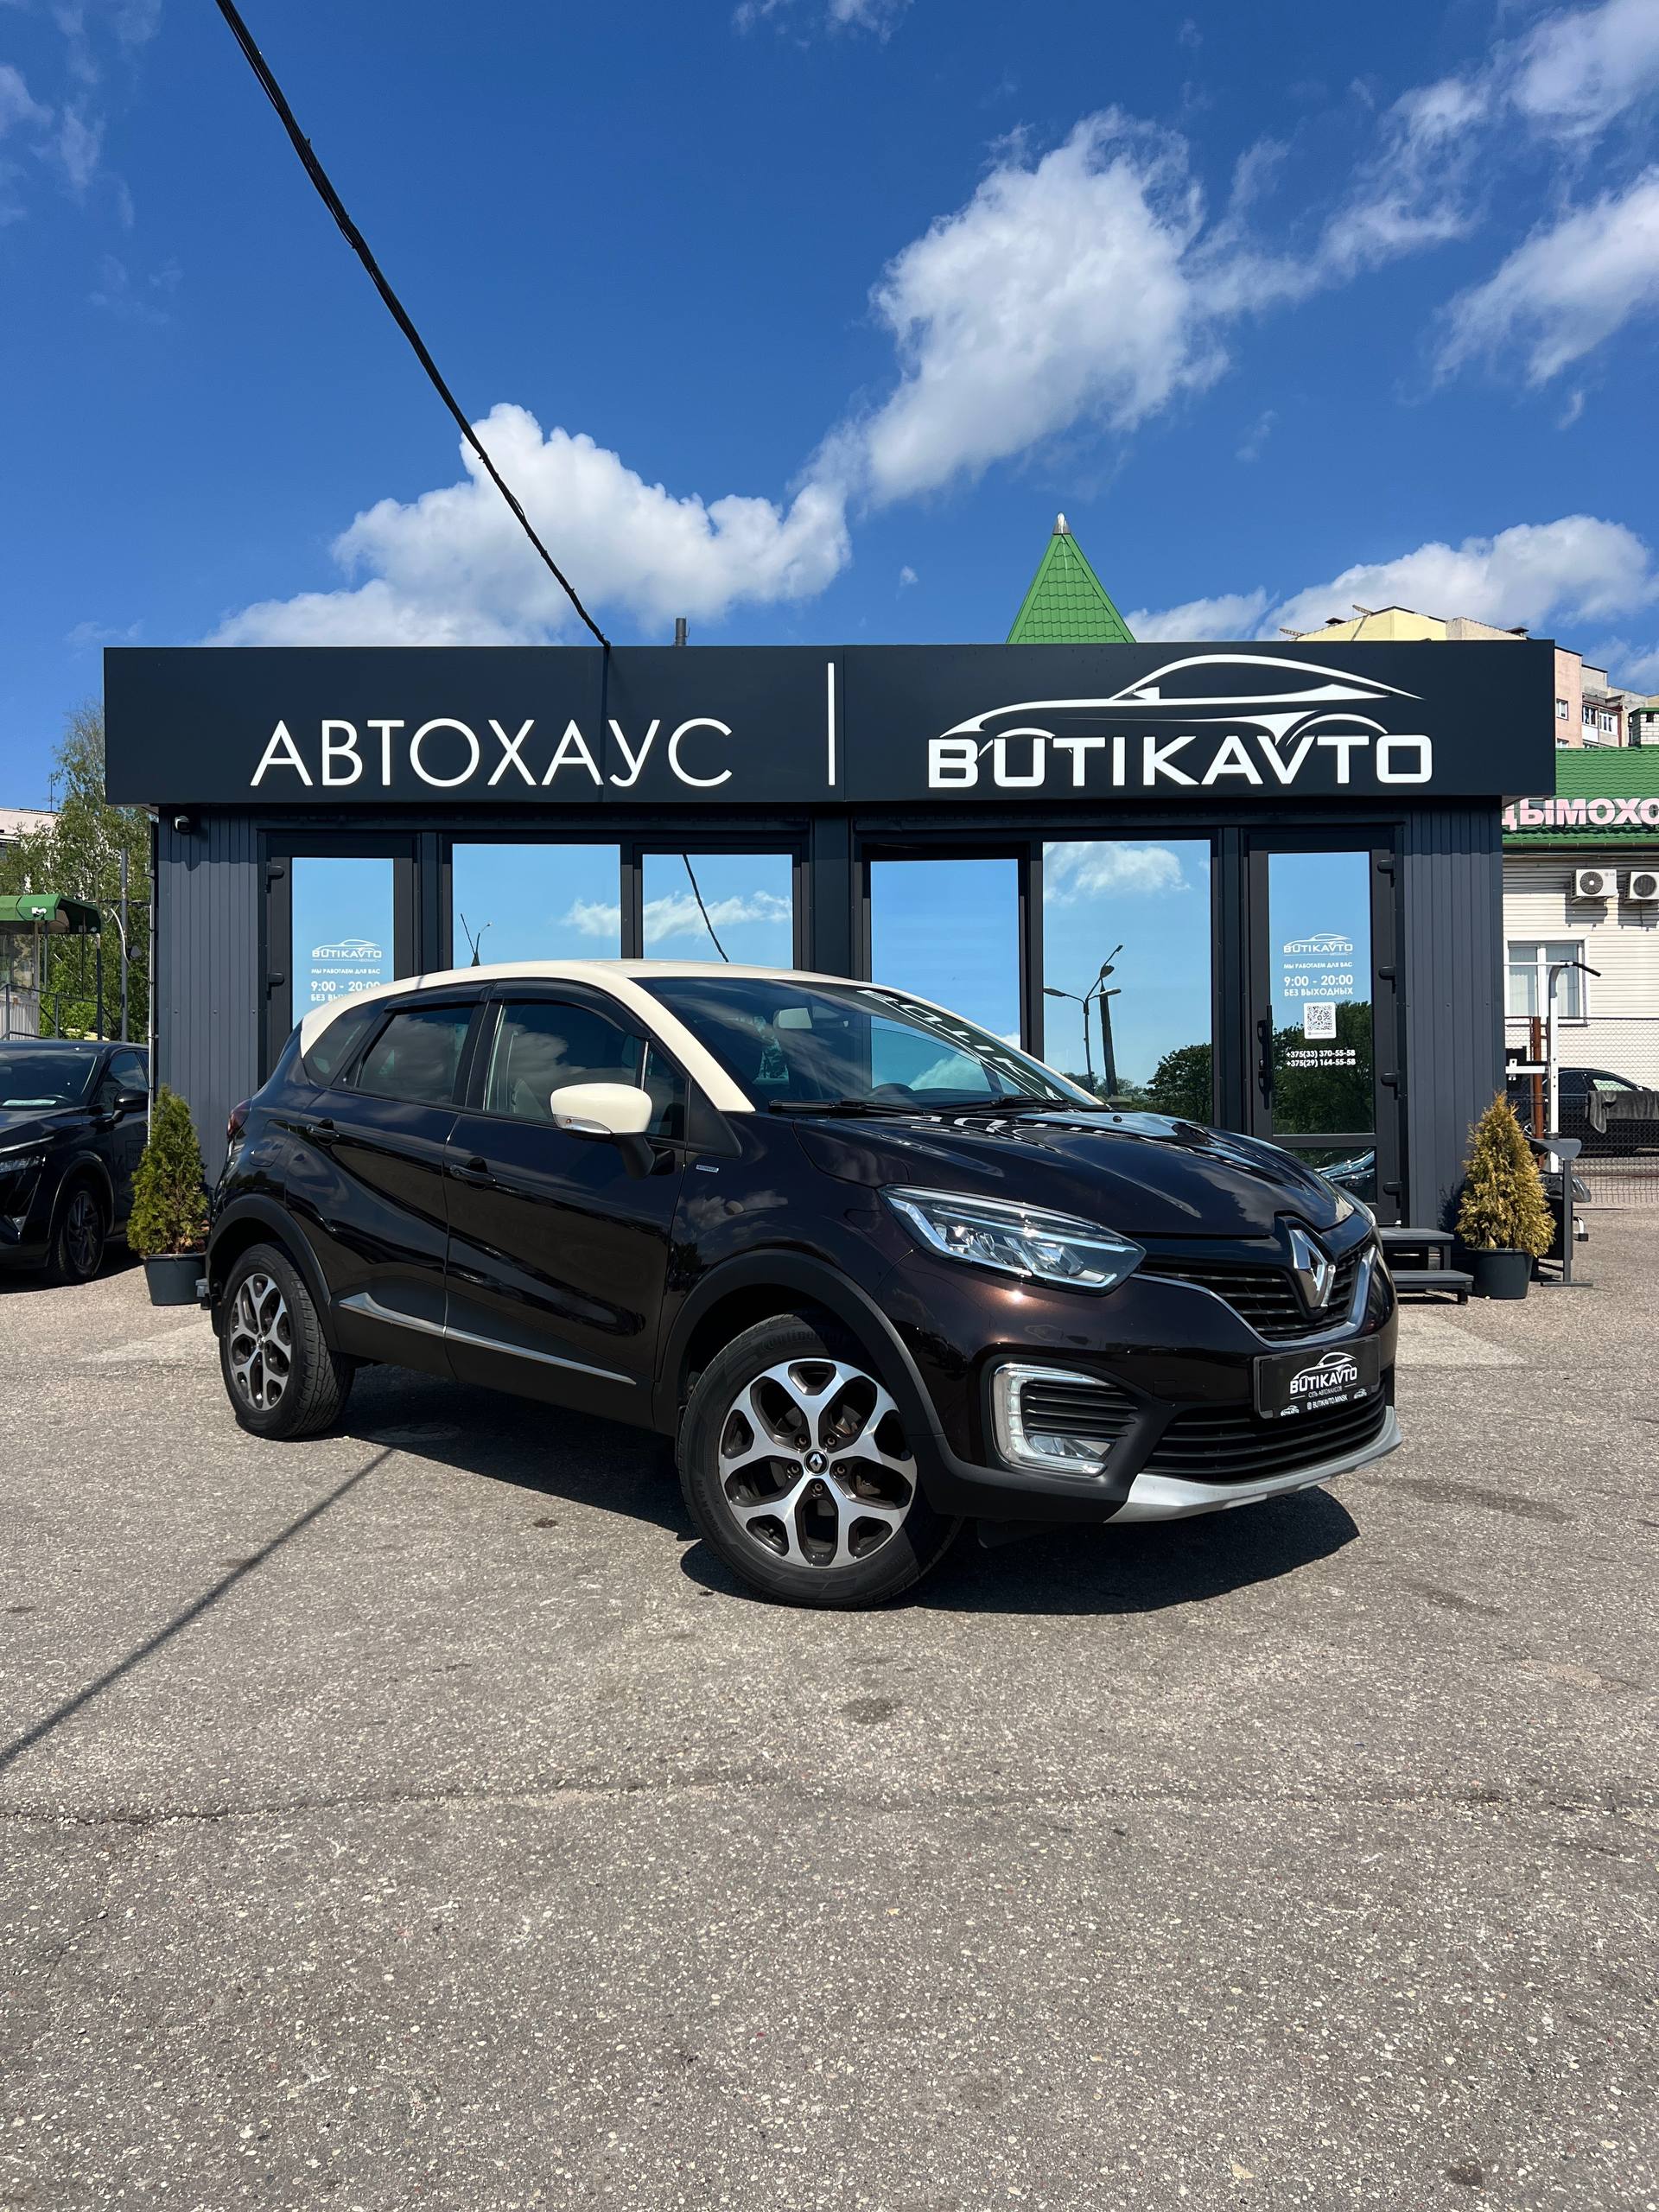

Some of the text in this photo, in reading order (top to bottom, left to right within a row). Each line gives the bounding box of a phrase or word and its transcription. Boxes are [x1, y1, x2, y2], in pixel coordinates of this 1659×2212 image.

[251, 717, 733, 787] АВТОХАУС
[928, 734, 1433, 788] BUTIKAVTO
[312, 950, 382, 958] BUTIKAVTO
[1283, 944, 1353, 953] BUTIKAVTO
[311, 981, 336, 992] 9:00
[1284, 976, 1309, 987] 9:00
[1321, 975, 1353, 986] 20:00
[1300, 988, 1353, 996] ВЫХОДНЫХ
[1290, 1367, 1357, 1394] BUTIKAVTO
